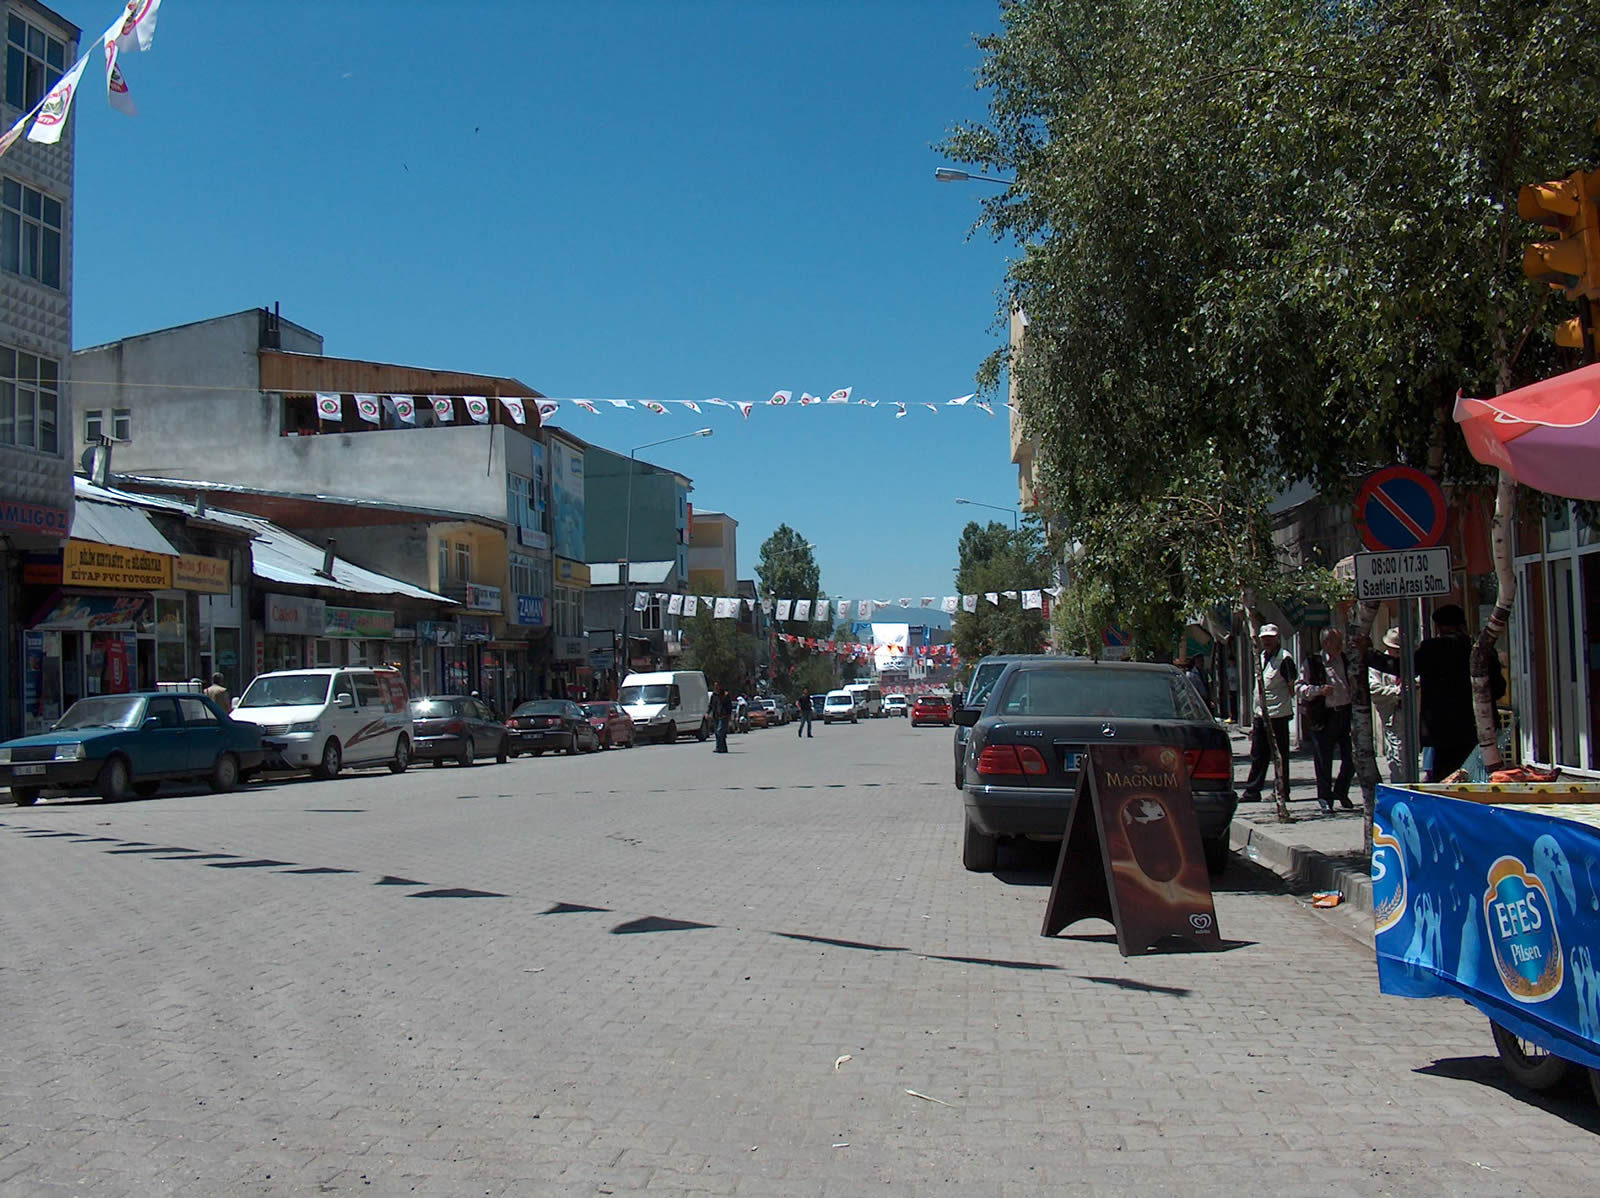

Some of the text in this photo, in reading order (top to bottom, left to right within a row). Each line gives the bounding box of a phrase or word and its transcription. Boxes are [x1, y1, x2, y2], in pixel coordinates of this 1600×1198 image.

[1371, 557, 1396, 575] 08:00
[1403, 554, 1428, 573] 17.30
[71, 568, 100, 581] KİTAP
[102, 573, 121, 583] PVC
[1363, 575, 1446, 596] Saatleri Arası 50m.
[519, 598, 543, 617] ZAMAN
[1105, 771, 1178, 788] MAGNUM
[1494, 891, 1542, 939] EFES
[1510, 943, 1542, 965] Pilsen
